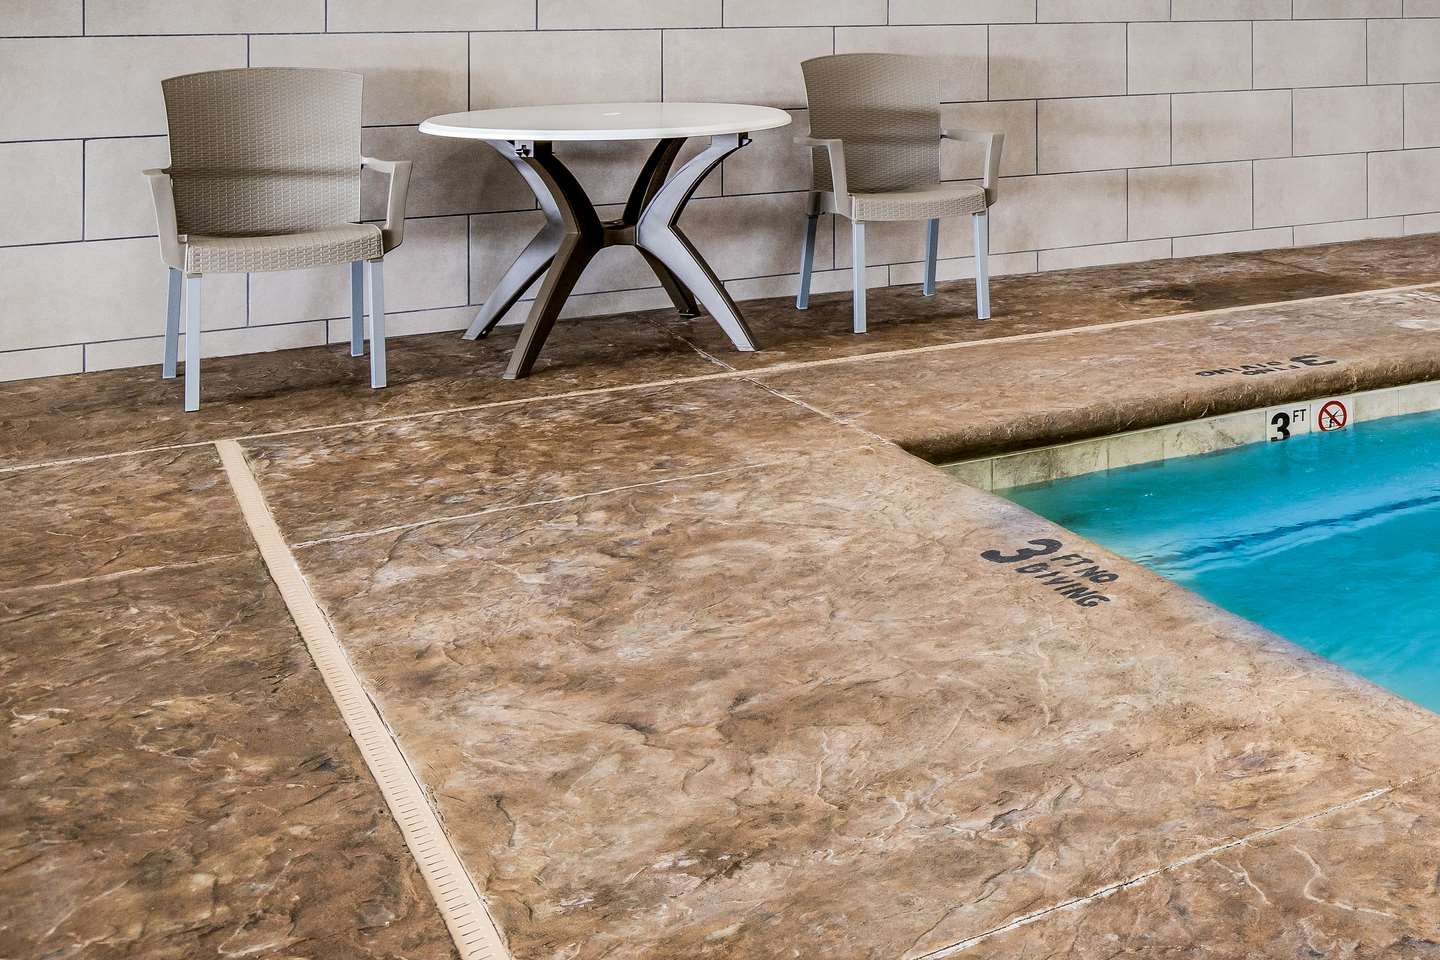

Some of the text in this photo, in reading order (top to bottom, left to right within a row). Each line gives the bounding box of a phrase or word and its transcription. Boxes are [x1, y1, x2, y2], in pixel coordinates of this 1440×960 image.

[1270, 409, 1307, 441] 3 FT
[980, 539, 1063, 563] 3
[1014, 562, 1111, 607] DIVING
